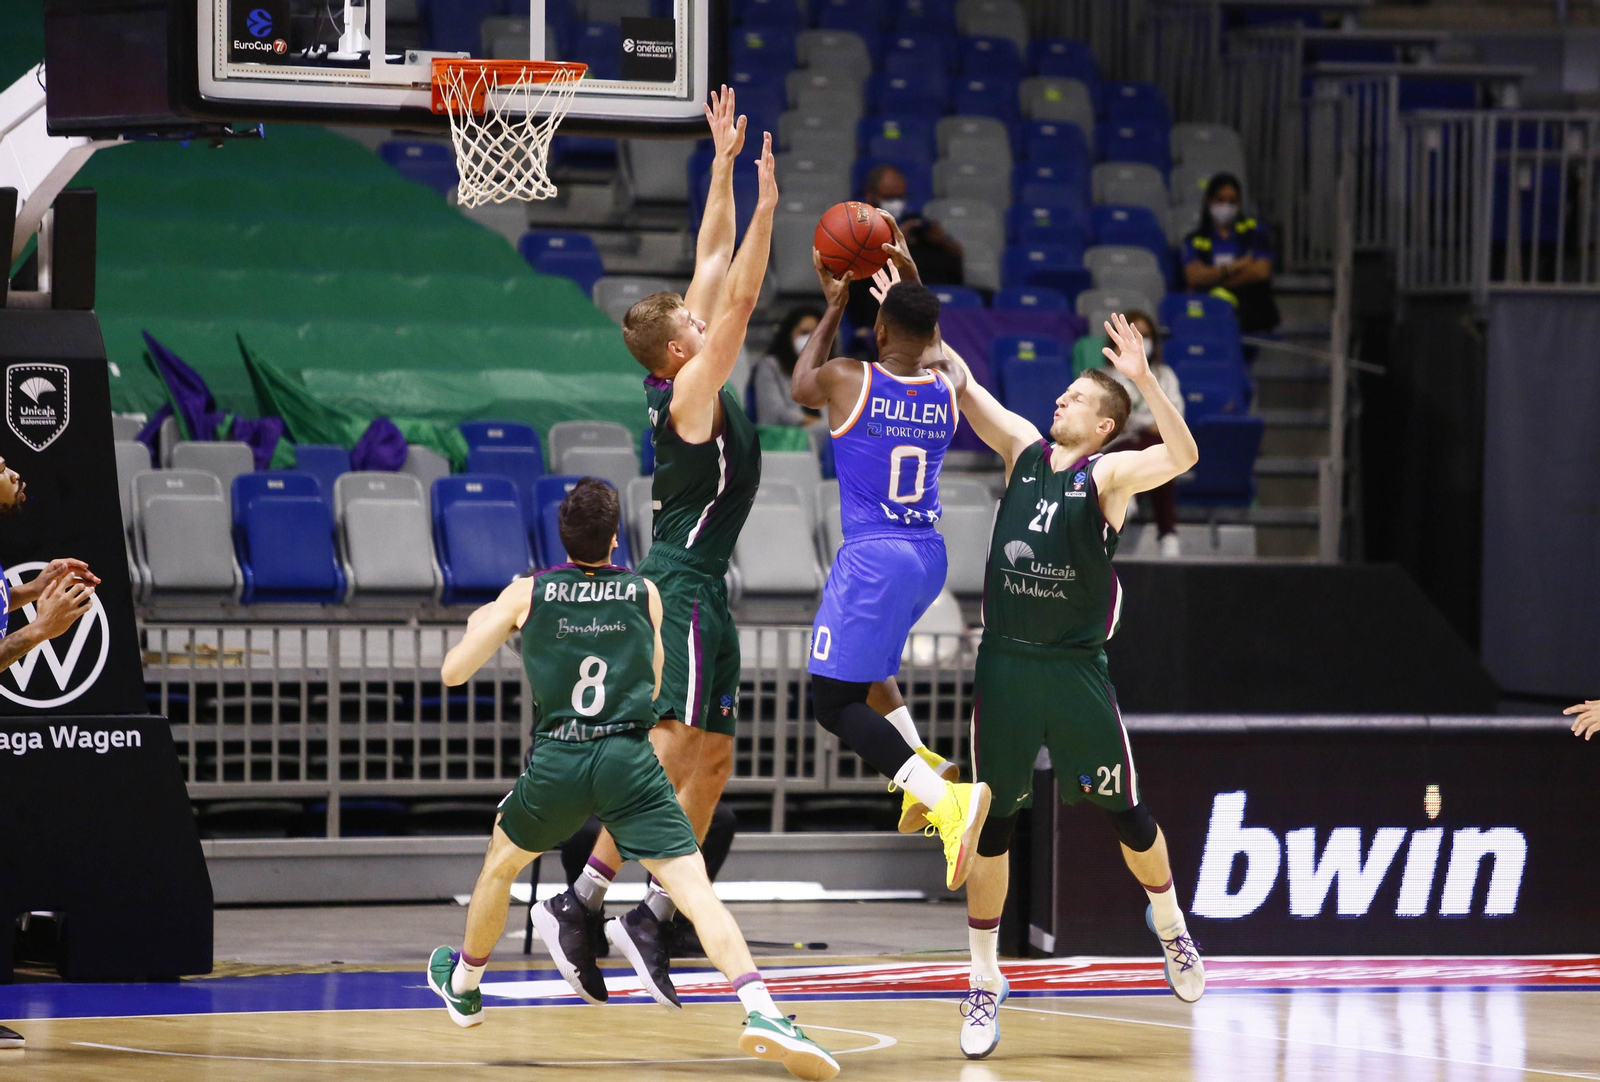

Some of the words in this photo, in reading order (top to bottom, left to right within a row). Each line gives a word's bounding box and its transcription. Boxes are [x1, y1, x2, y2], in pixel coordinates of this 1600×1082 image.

[233, 40, 272, 52] EuroCup
[636, 45, 674, 53] oneteam
[20, 405, 55, 418] Unicaja
[871, 397, 948, 424] PULLEN
[886, 426, 912, 437] PORT
[913, 428, 926, 439] OF
[928, 430, 946, 439] BAR
[888, 445, 928, 504] 0
[1028, 498, 1059, 534] 21
[1030, 561, 1076, 579] Unicaja
[544, 581, 637, 603] BRIZUELA
[1003, 573, 1068, 600] Andalucía
[813, 625, 832, 661] 0
[571, 655, 608, 717] 8
[49, 725, 141, 754] Wagen
[1096, 763, 1122, 796] 21
[1191, 784, 1528, 918] bwin
